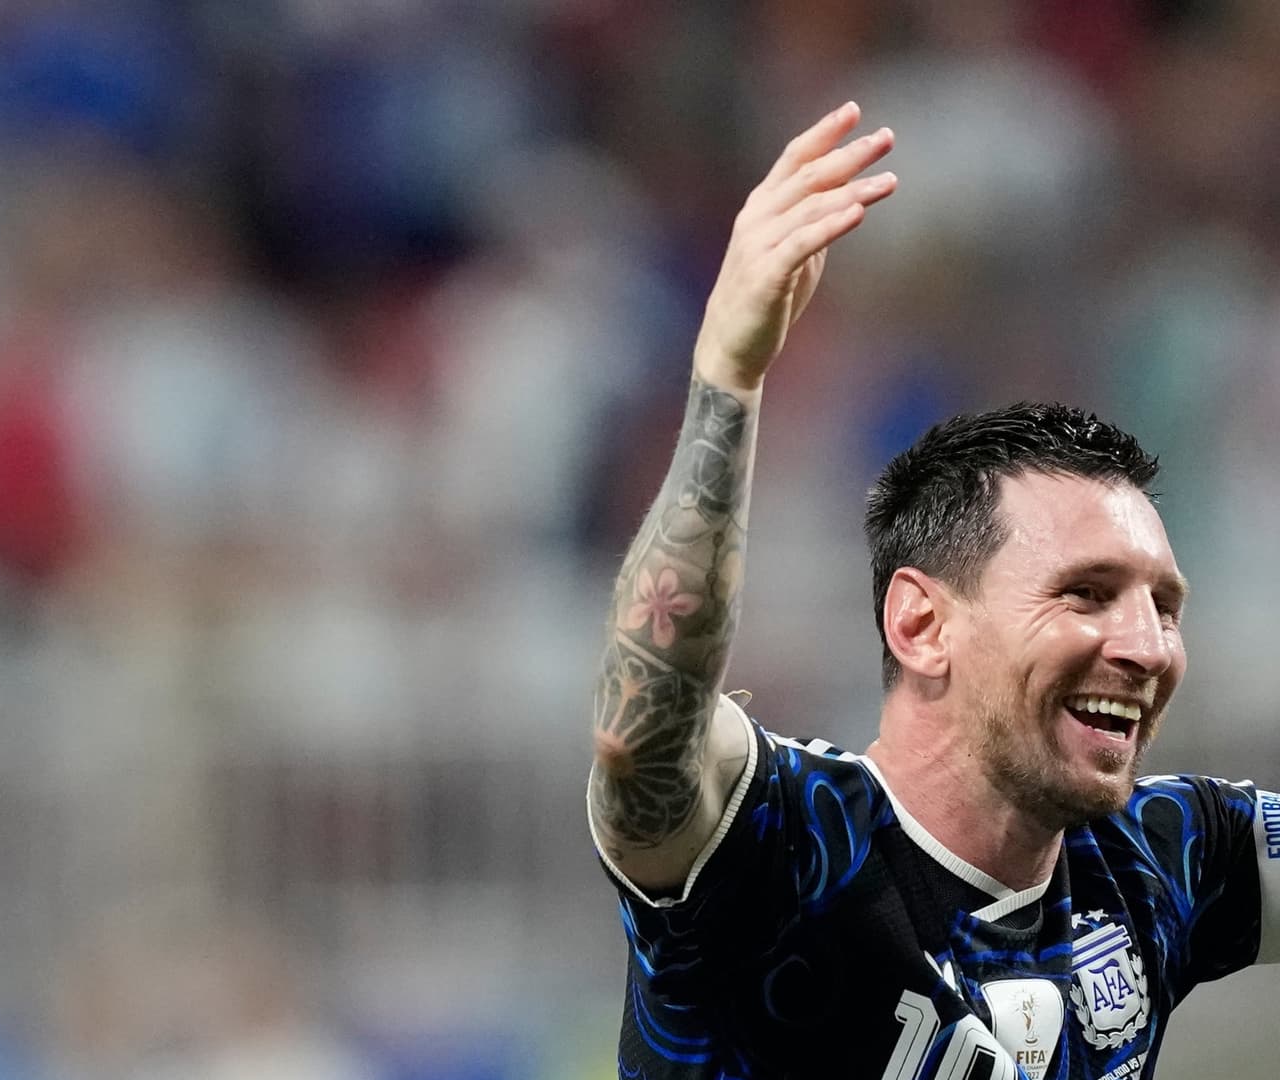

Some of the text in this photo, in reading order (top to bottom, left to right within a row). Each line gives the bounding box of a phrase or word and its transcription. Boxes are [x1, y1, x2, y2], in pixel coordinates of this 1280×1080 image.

[1087, 958, 1135, 1013] AFA
[1016, 1050, 1046, 1065] FIFA
[1127, 1057, 1140, 1070] VS
